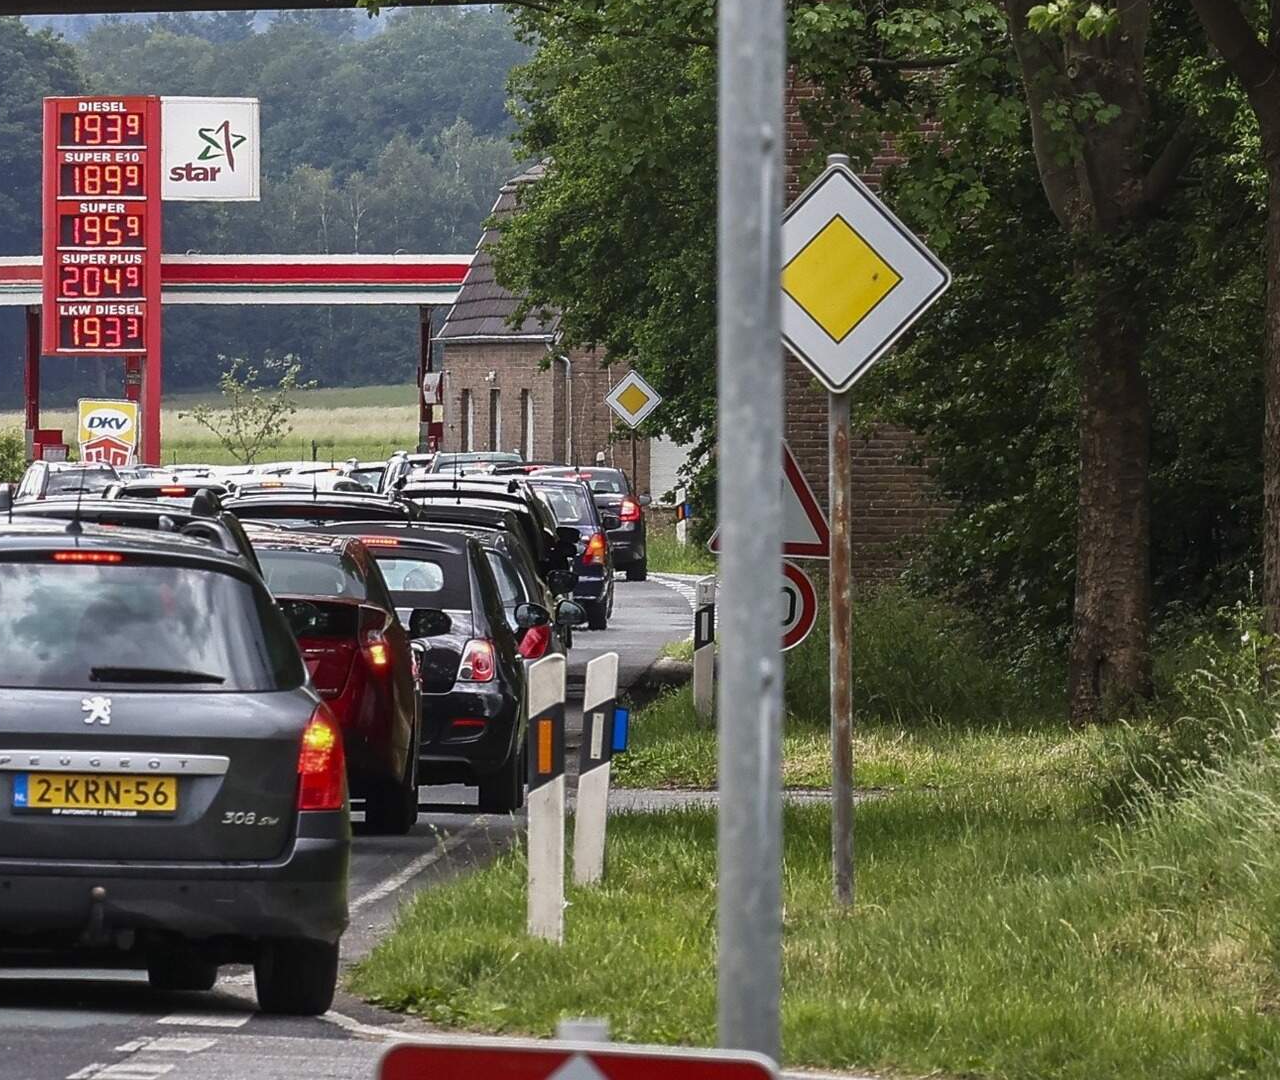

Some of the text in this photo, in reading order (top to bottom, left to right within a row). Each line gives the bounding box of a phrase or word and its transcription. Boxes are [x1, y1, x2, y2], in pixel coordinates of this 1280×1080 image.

[78, 102, 127, 112] DIESEL
[65, 152, 139, 162] SUPER E10
[170, 162, 221, 182] star
[79, 203, 125, 213] SUPER
[62, 254, 142, 264] SUPER PLUS
[60, 304, 143, 316] LKW DIESEL
[87, 416, 128, 429] DKV
[0, 756, 189, 769] PEUGEOT
[36, 778, 169, 806] 2-KRN-56
[221, 811, 257, 825] 308
